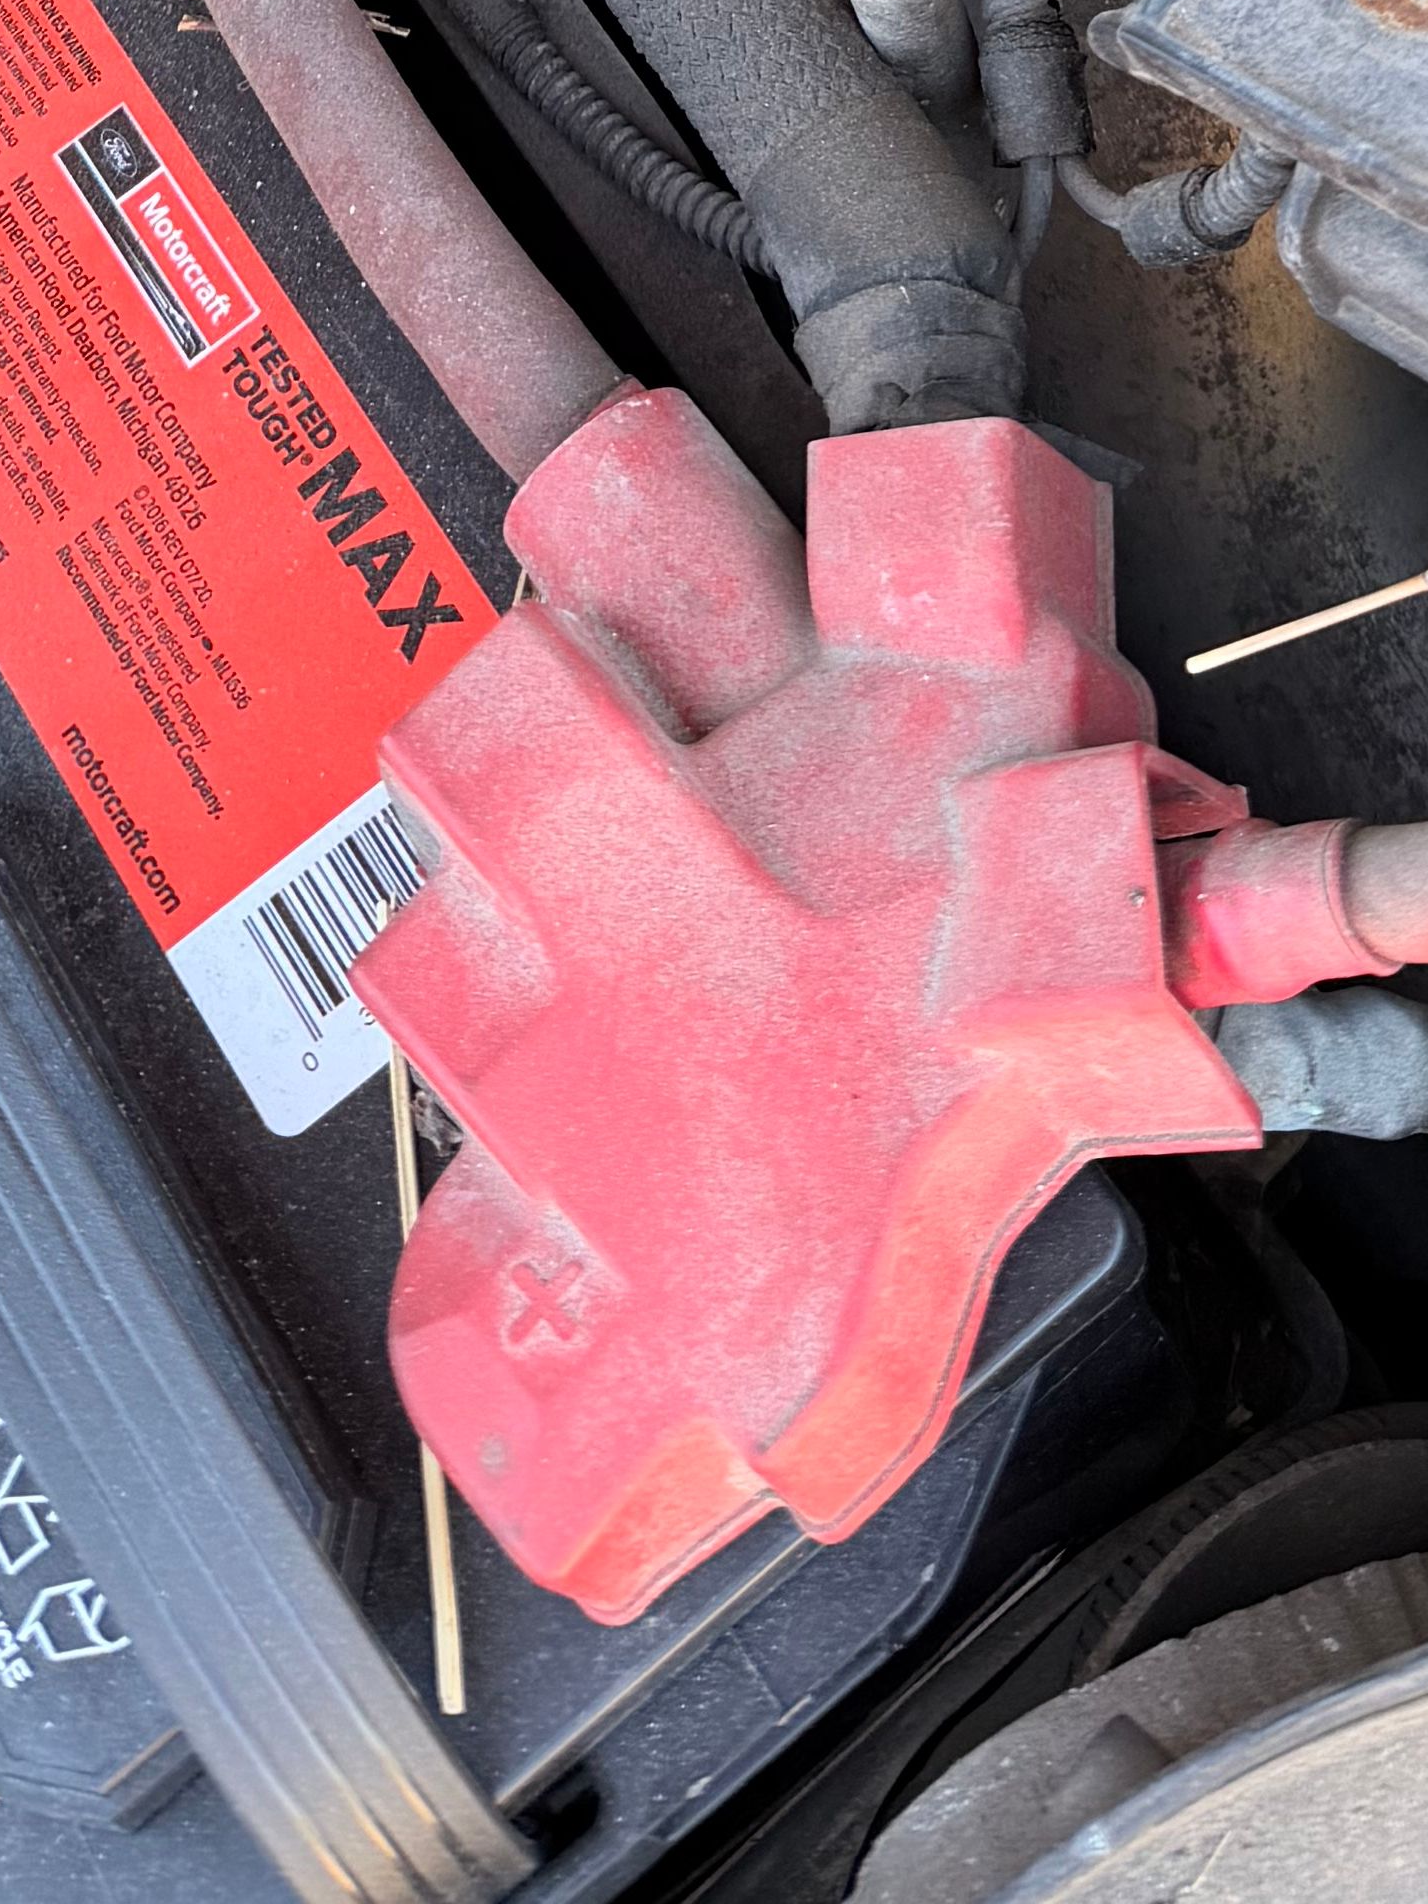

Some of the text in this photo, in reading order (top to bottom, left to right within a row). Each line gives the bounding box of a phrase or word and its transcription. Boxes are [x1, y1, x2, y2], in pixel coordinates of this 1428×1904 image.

[41, 39, 62, 60] and
[53, 56, 83, 92] related
[50, 14, 69, 33] 65
[60, 28, 102, 87] WARNING:
[0, 87, 25, 118] cancer
[0, 125, 19, 148] also
[100, 130, 138, 176] Ford
[139, 191, 232, 325] Motorcraft
[9, 280, 33, 313] Your
[25, 309, 62, 365] Receipt.
[10, 172, 218, 491] Manufactured for Ford Motor Company
[6, 362, 22, 381] is
[14, 377, 60, 446] removed.
[8, 323, 28, 348] For
[21, 343, 63, 406] Warranty
[55, 400, 102, 476] Protection.
[37, 271, 77, 326] Road,
[66, 317, 121, 404] Dearborn,
[114, 397, 170, 479] Michigan
[165, 475, 207, 531] 48126
[250, 324, 338, 450] TESTED
[22, 446, 43, 472] see
[36, 470, 70, 522] dealer,
[115, 498, 145, 535] Ford
[134, 530, 167, 575] Motor
[161, 528, 189, 561] REV
[179, 558, 213, 609] 07/20,
[296, 446, 465, 665] MAX
[74, 530, 211, 753] trademark of Ford Motor Company.
[139, 592, 153, 611] is
[146, 607, 159, 621] a
[55, 544, 225, 821] Recommended by Ford Motor Company.
[152, 617, 201, 685] registered
[61, 723, 181, 915] motorcraft.com
